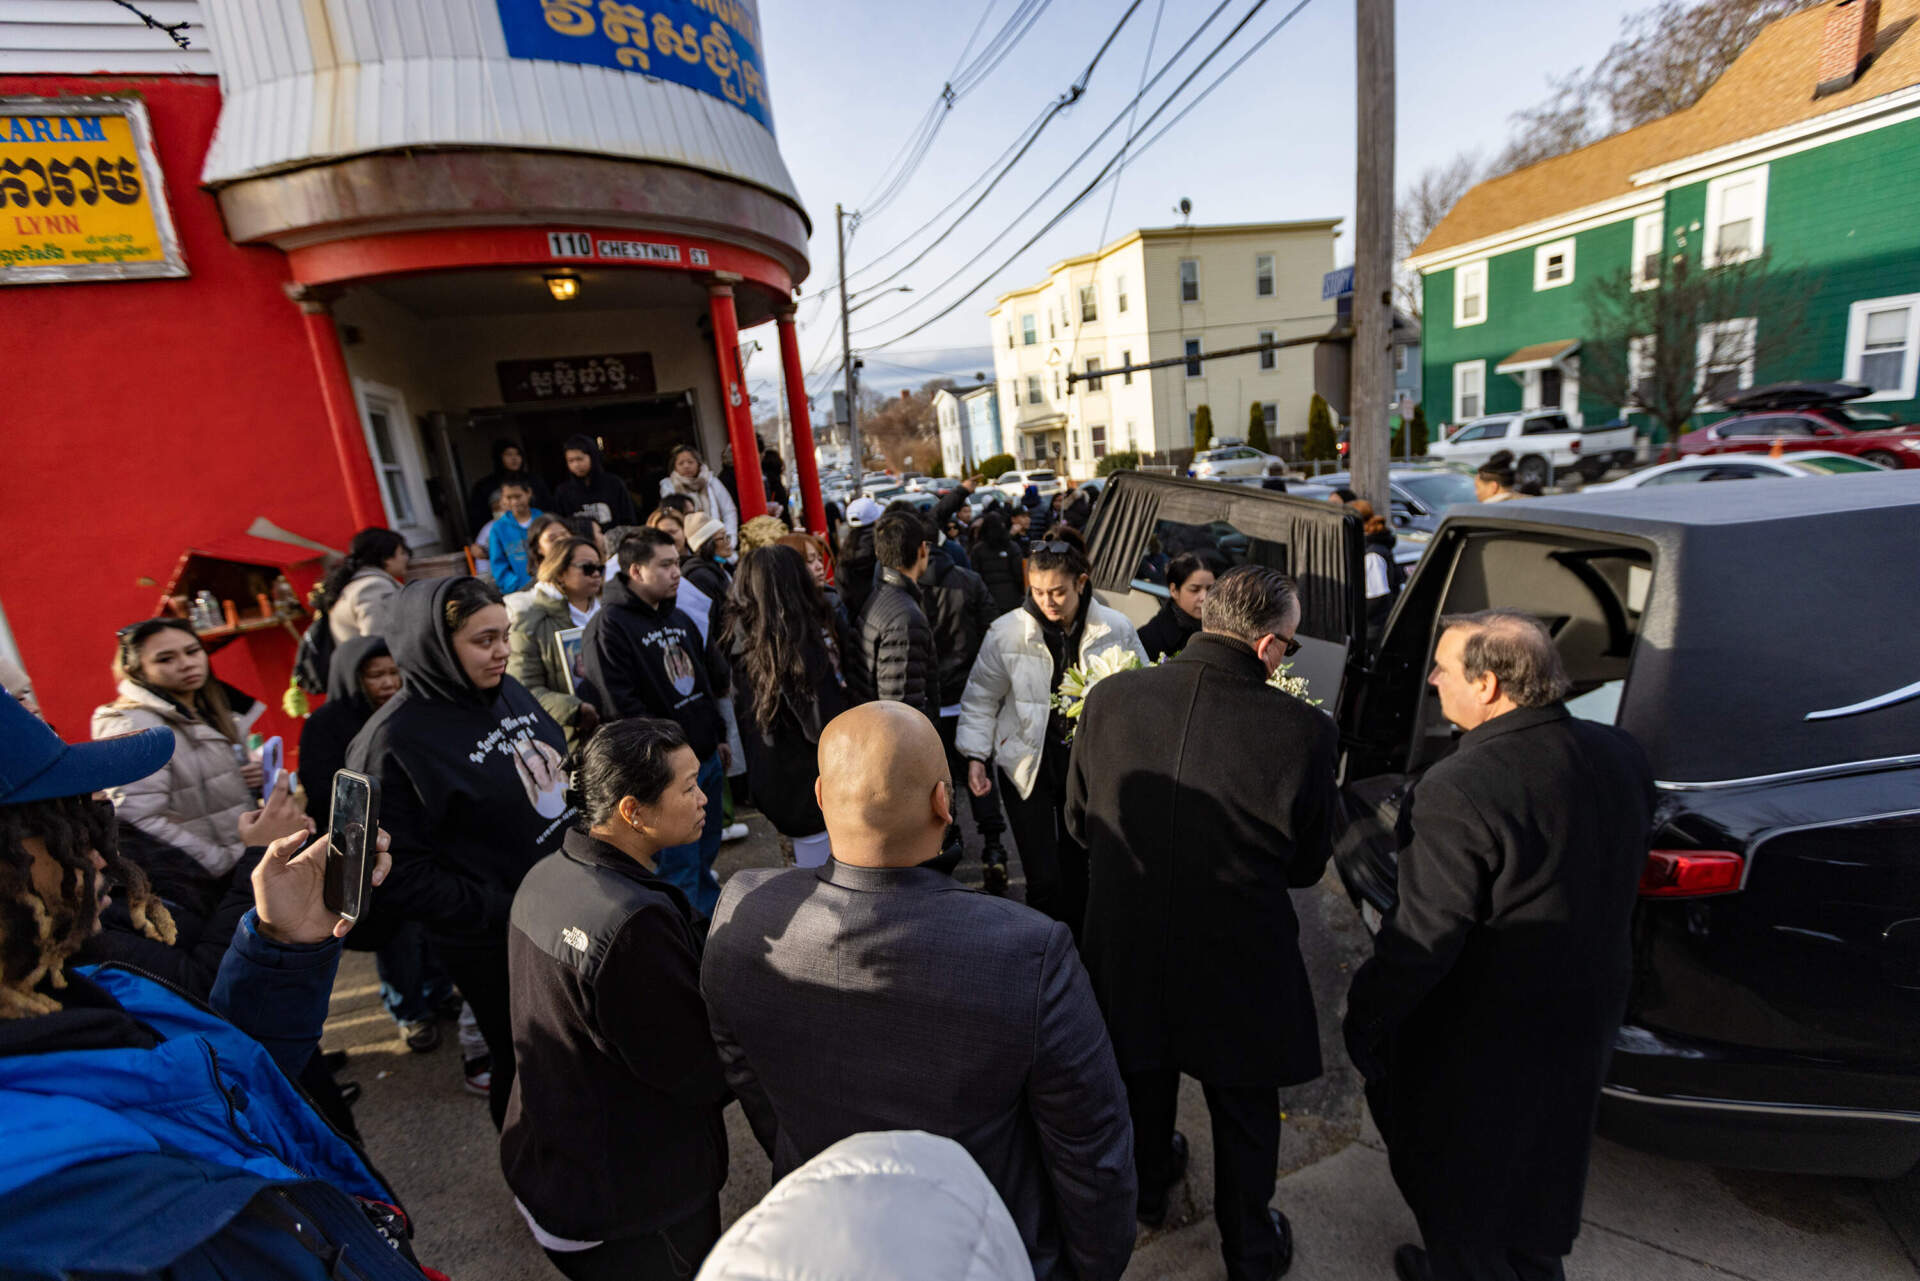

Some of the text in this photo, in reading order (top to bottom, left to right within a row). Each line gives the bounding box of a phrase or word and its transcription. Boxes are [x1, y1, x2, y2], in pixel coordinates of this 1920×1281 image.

[0, 117, 108, 142] ARAM
[14, 215, 82, 235] LYNN
[552, 233, 707, 264] 110 CHESTNUT ST
